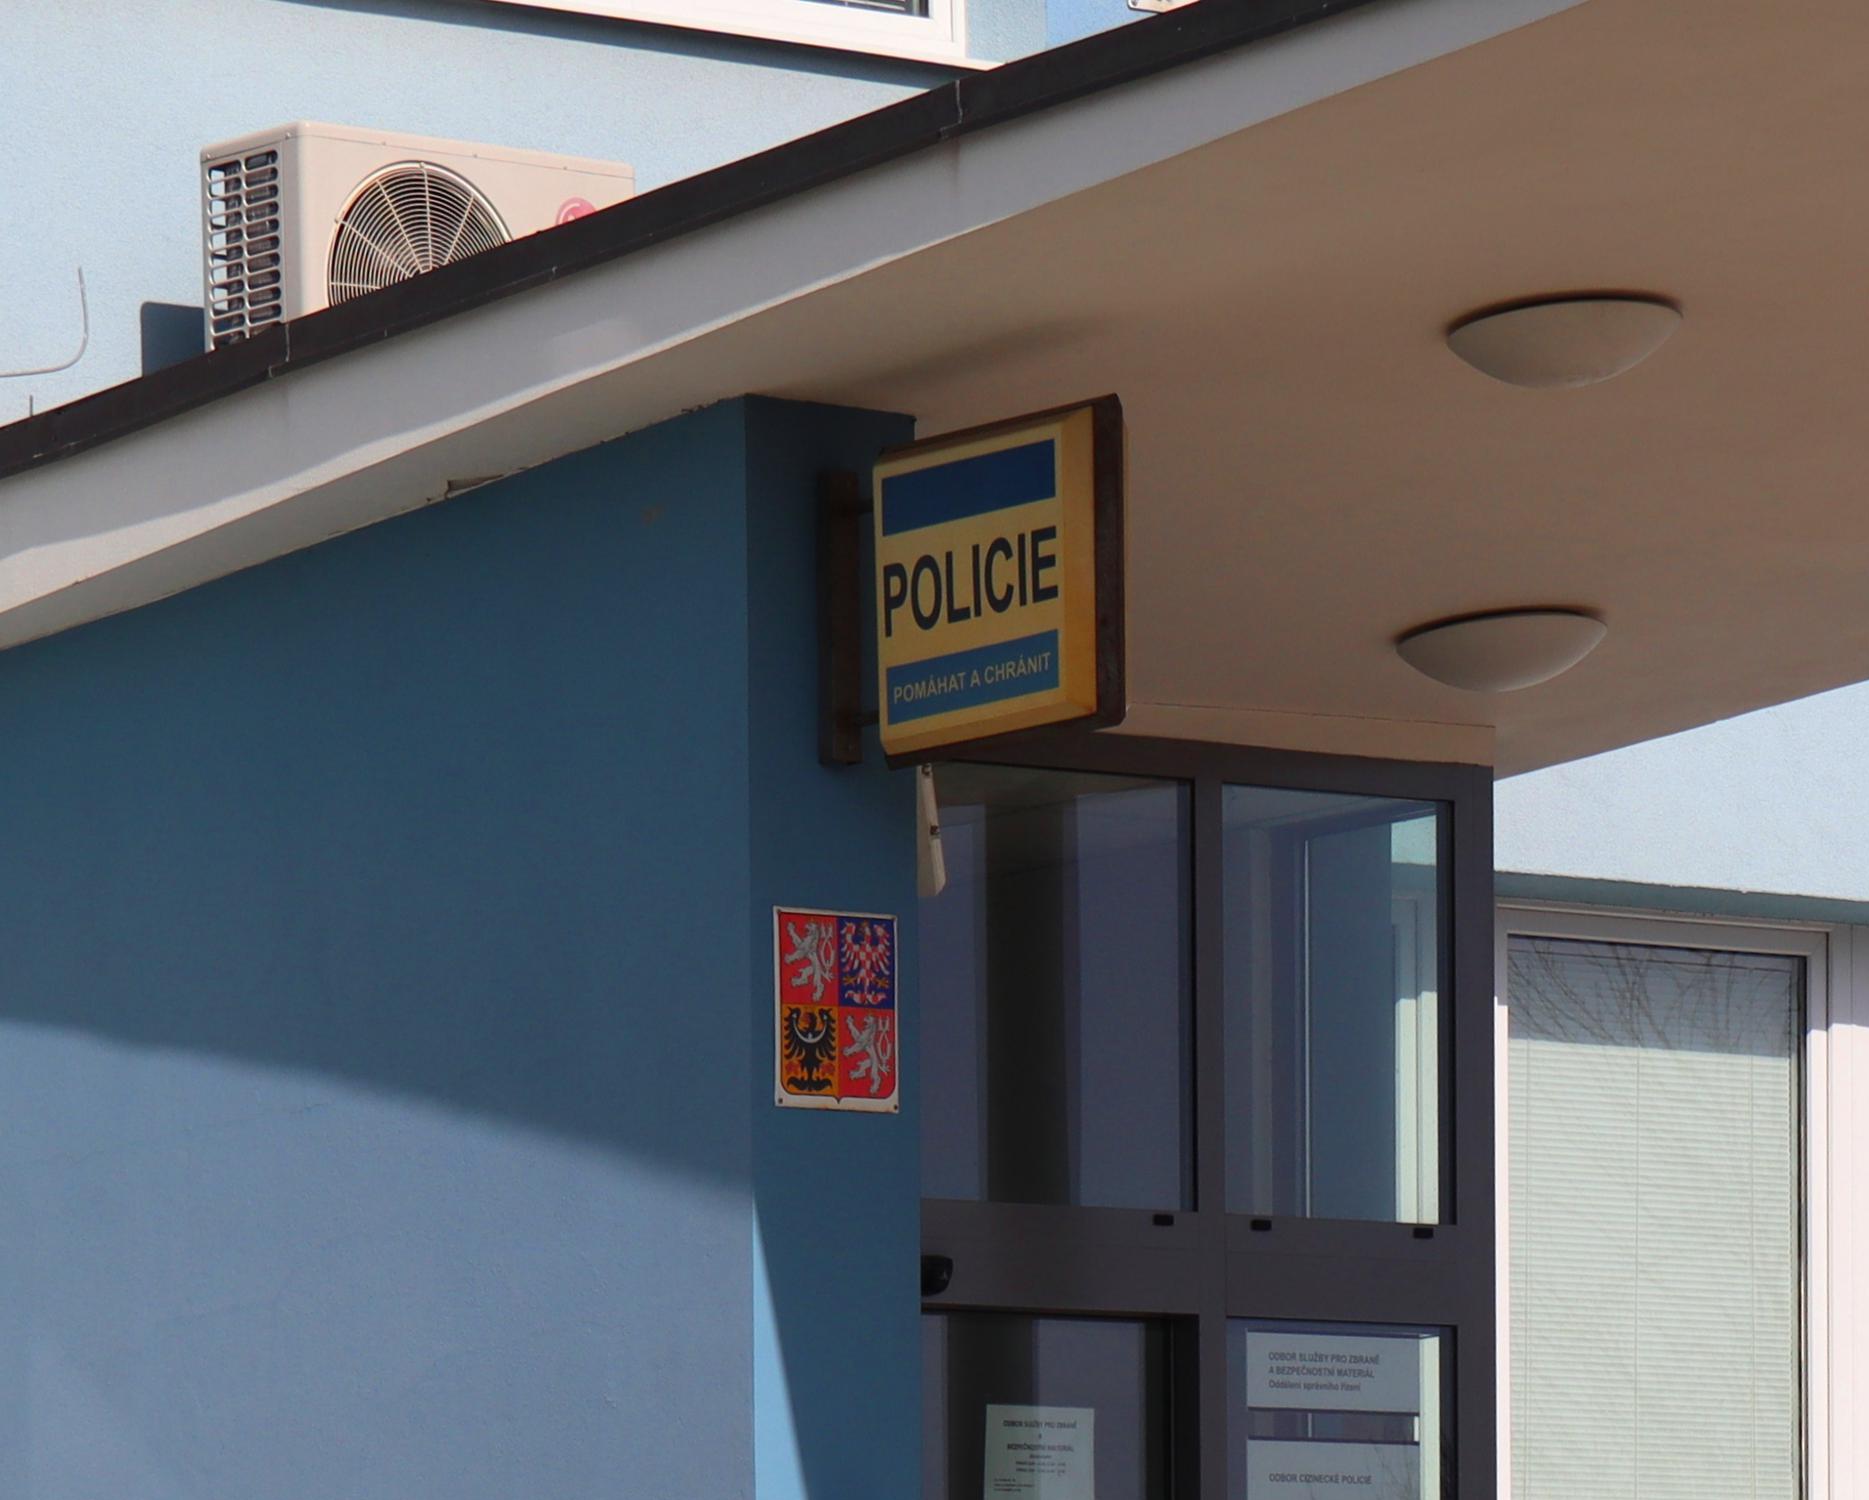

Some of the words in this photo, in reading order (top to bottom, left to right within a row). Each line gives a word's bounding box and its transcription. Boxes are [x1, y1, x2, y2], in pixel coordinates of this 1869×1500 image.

[883, 525, 1058, 638] POLICIE
[893, 671, 966, 704] POMÁHAT
[970, 669, 981, 687] A
[984, 652, 1052, 686] CHRÁNIT
